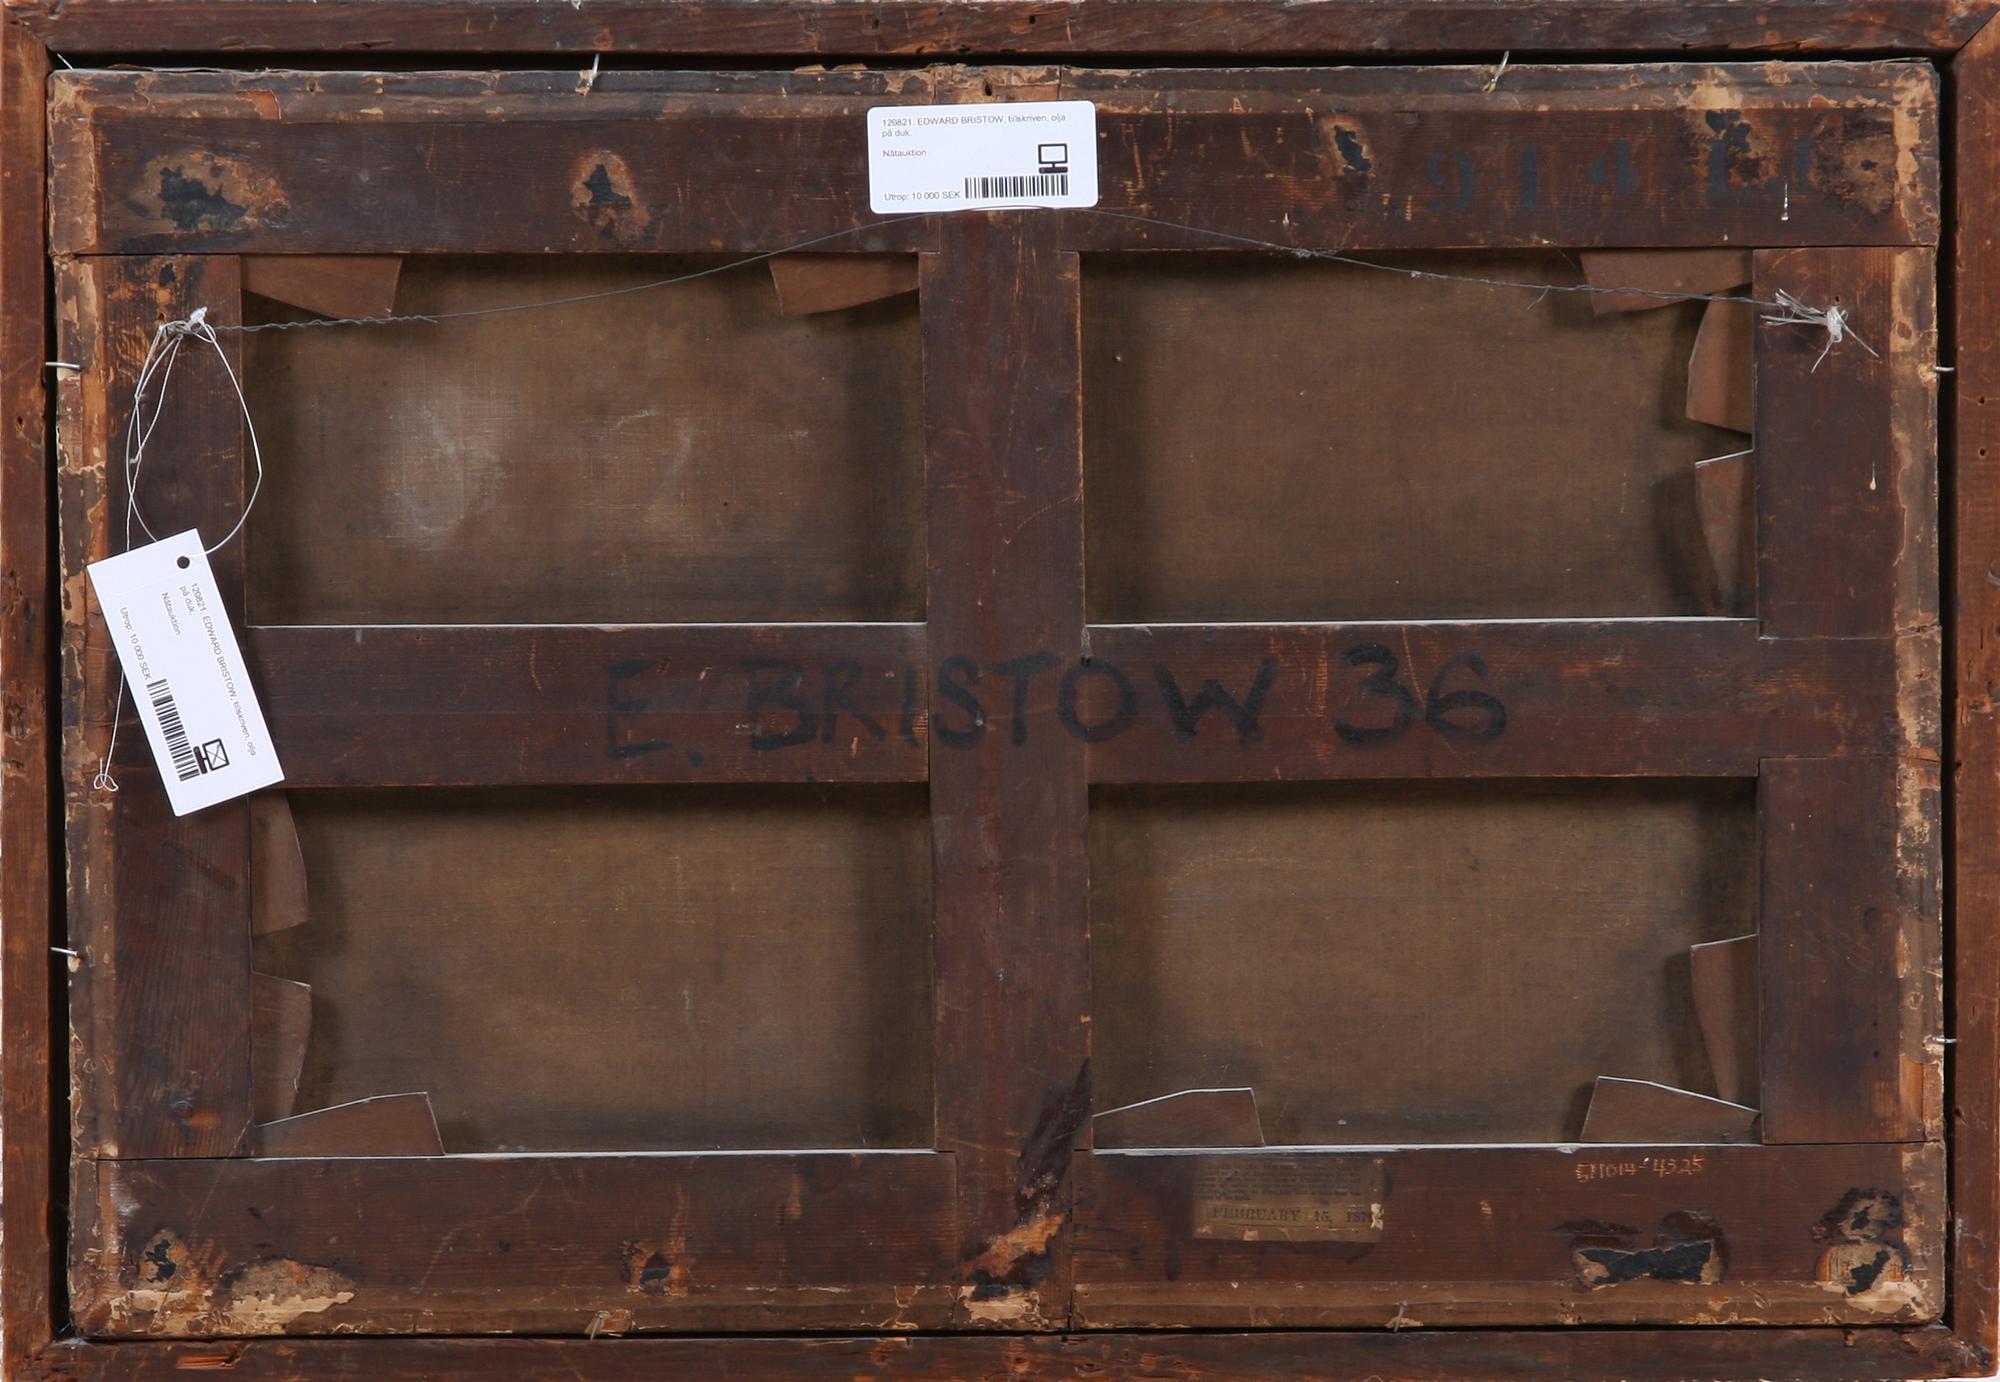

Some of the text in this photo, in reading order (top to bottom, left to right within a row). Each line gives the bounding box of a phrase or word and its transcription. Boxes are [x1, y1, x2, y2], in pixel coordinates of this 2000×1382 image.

[917, 116, 959, 126] EDWARD
[961, 115, 1006, 125] BRISTOW,
[1051, 113, 1066, 123] olja
[882, 128, 892, 138] på
[882, 148, 927, 157] Nätauktion
[884, 190, 961, 202] Utrop: 10 000 SEK
[179, 585, 190, 598] på
[120, 607, 133, 632] Utrop:
[161, 592, 182, 636] Nätauktion
[202, 615, 221, 656] EDWARD
[133, 645, 145, 661] 000
[138, 661, 152, 681] SEK
[605, 643, 1508, 768] E. BRISTOW 36
[1211, 1206, 1300, 1222] FEBRUARY
